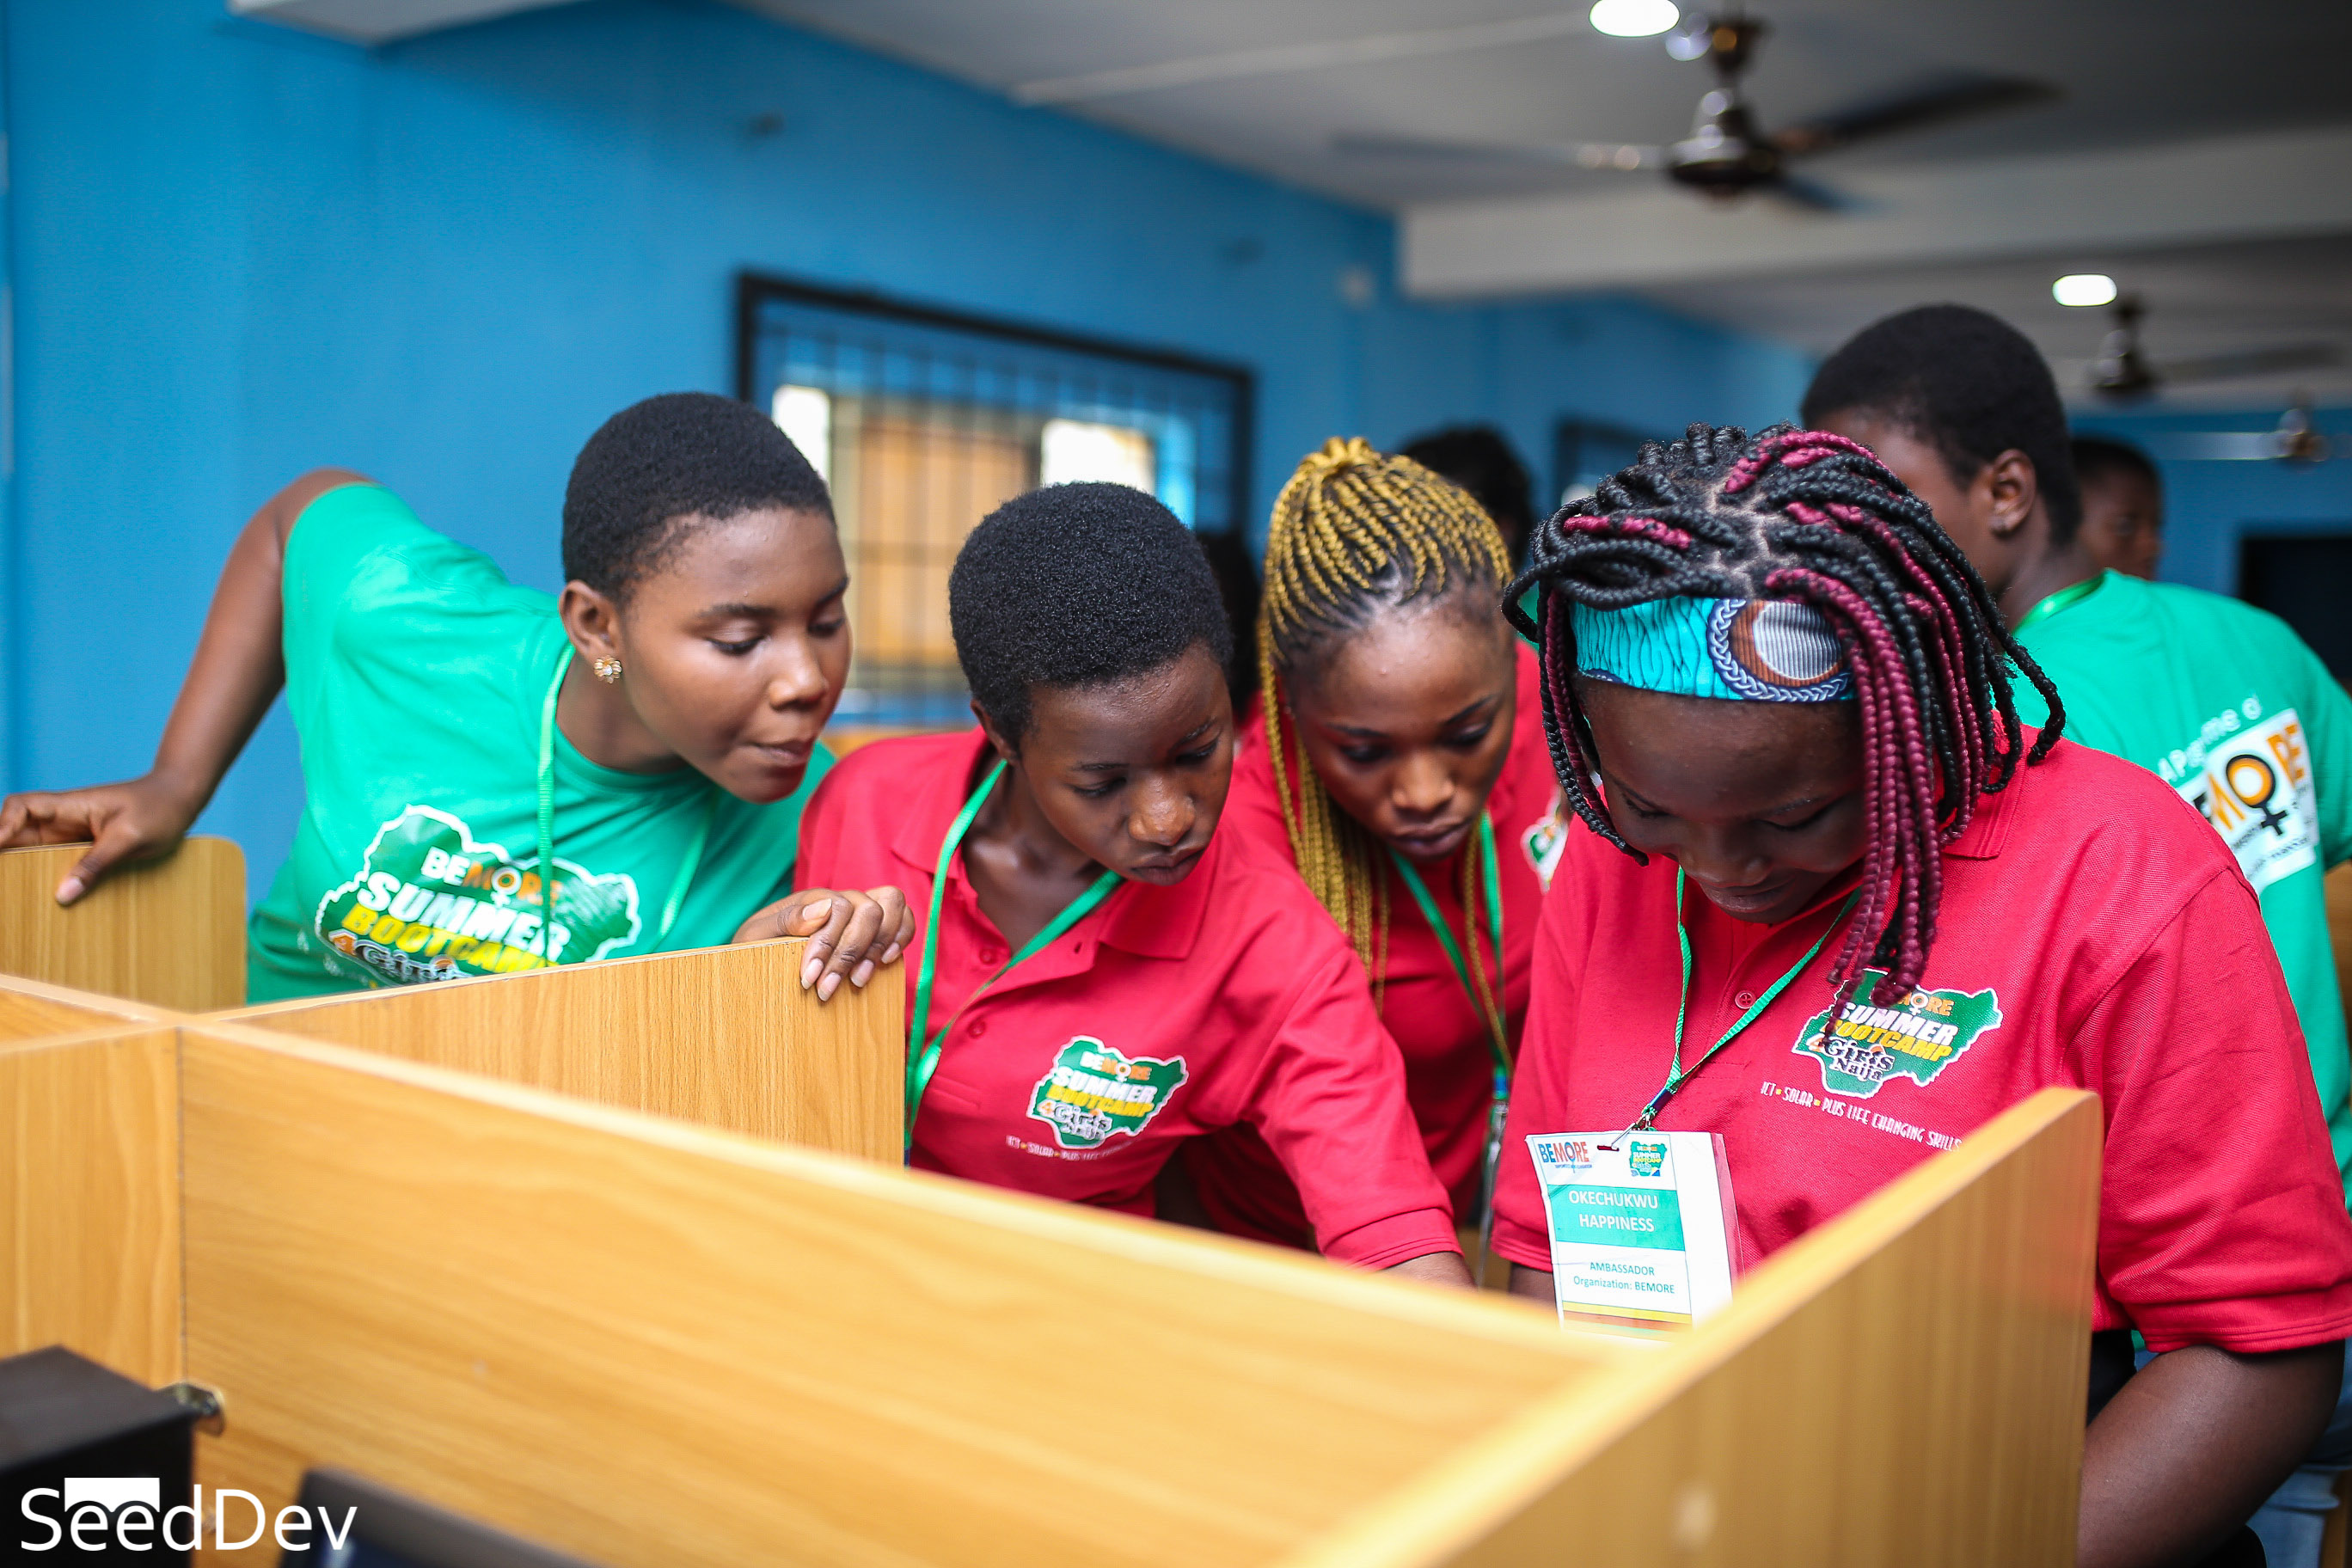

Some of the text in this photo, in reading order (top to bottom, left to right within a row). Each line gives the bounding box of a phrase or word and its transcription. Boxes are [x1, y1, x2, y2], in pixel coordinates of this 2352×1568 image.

[357, 872, 572, 963] SUMMER
[341, 902, 560, 974] BOOTCAM
[1838, 1001, 1959, 1046] SUMMER
[1080, 1050, 1152, 1081] BEMORE
[1830, 1057, 1884, 1081] Naija
[1051, 1066, 1158, 1104] SUMMER
[1045, 1084, 1155, 1118] BOOTCAMP
[1761, 1081, 1963, 1153] ICT SOLAR PLUS LIFE CHANGING SKILLS
[1538, 1142, 1589, 1163] BEMORE
[1568, 1190, 1659, 1210] OKECHUKWU
[1578, 1213, 1656, 1233] HAPPINESS
[1589, 1261, 1656, 1277] AMBASSADOR
[1573, 1276, 1675, 1295] Organization: BEMORE
